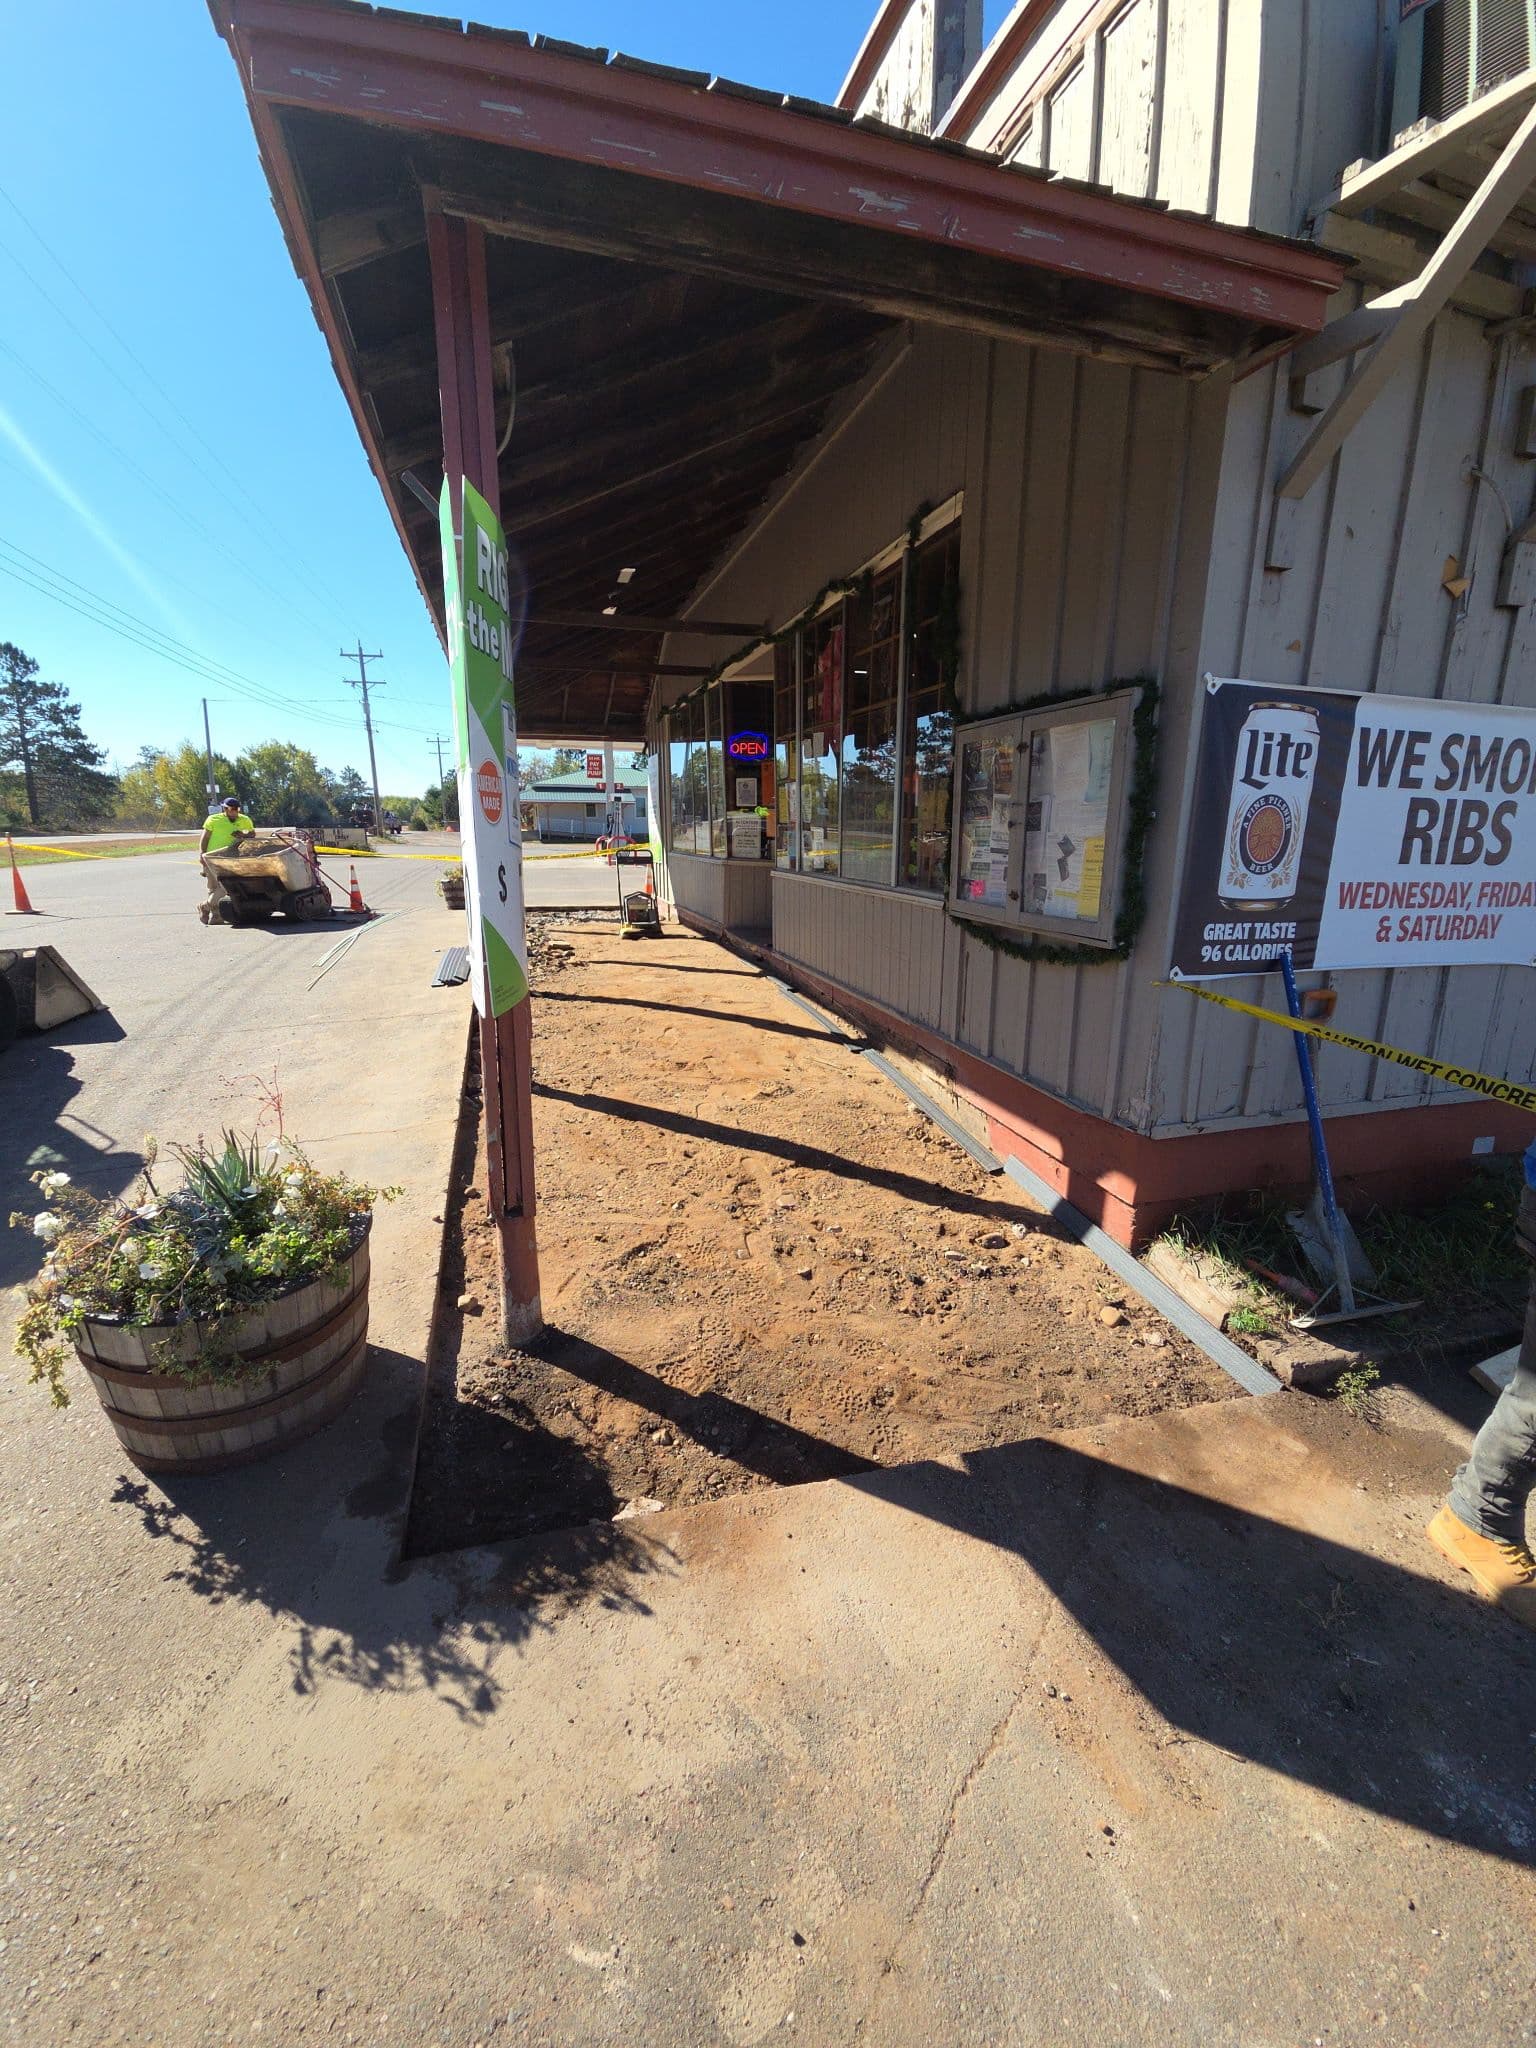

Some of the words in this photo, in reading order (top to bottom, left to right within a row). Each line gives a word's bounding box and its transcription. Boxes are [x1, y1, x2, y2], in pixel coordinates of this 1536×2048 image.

[477, 524, 509, 616] RIG
[467, 600, 499, 660] the
[501, 619, 513, 681] M
[730, 742, 765, 754] OPEN
[1239, 729, 1313, 790] Lite
[1357, 726, 1432, 788] WE
[482, 796, 501, 810] MADE
[1247, 797, 1266, 819] FINE
[1268, 796, 1291, 830] PILSNER
[1398, 796, 1518, 866] RIBS
[497, 860, 507, 907] $
[1249, 862, 1274, 873] BEER
[1338, 882, 1473, 911] WEDNESDAY,
[1476, 882, 1536, 908] FRIDA
[1203, 922, 1252, 940] GREAT
[1254, 922, 1297, 939] TASTE
[1376, 916, 1390, 943] &
[1396, 914, 1503, 942] SATURDAY
[1201, 944, 1222, 962] 96
[1224, 943, 1293, 962] CALORIES
[1397, 1053, 1443, 1076] WET
[1445, 1069, 1536, 1110] CONCRE
